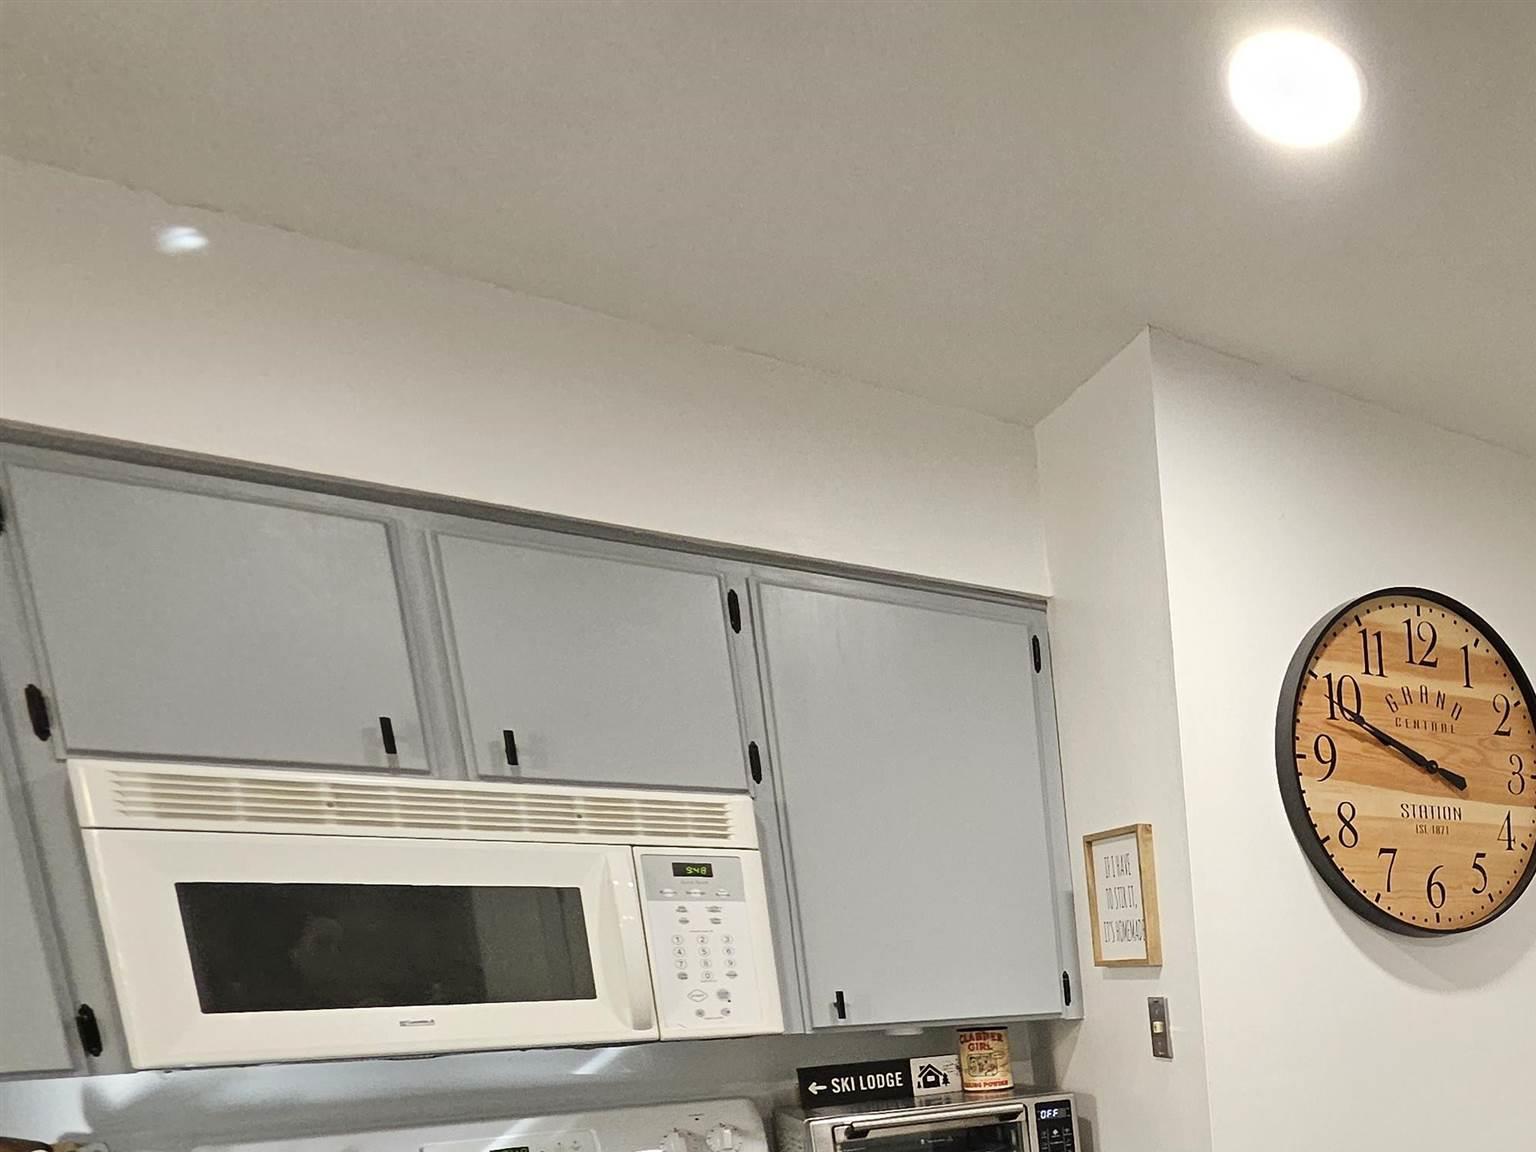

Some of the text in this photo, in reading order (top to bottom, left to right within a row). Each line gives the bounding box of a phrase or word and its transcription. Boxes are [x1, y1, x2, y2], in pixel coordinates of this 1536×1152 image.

[1358, 628, 1388, 678] 11
[1402, 618, 1439, 668] 12
[1460, 644, 1474, 688] 1
[1323, 672, 1362, 721] 10
[1385, 685, 1462, 721] GRAND
[1492, 694, 1511, 736] 2
[1395, 717, 1456, 734] CENTRAL
[1313, 734, 1338, 782] 9
[1508, 754, 1525, 795] 3
[1337, 801, 1359, 848] 8
[1401, 804, 1462, 821] STATION
[1497, 810, 1517, 851] 4
[1377, 848, 1398, 893] 7
[1426, 865, 1446, 909] 6
[1471, 852, 1488, 894] 5
[968, 1041, 993, 1051] GIRL
[831, 1071, 904, 1094] SKI LODGE
[1040, 1108, 1059, 1119] OFF
